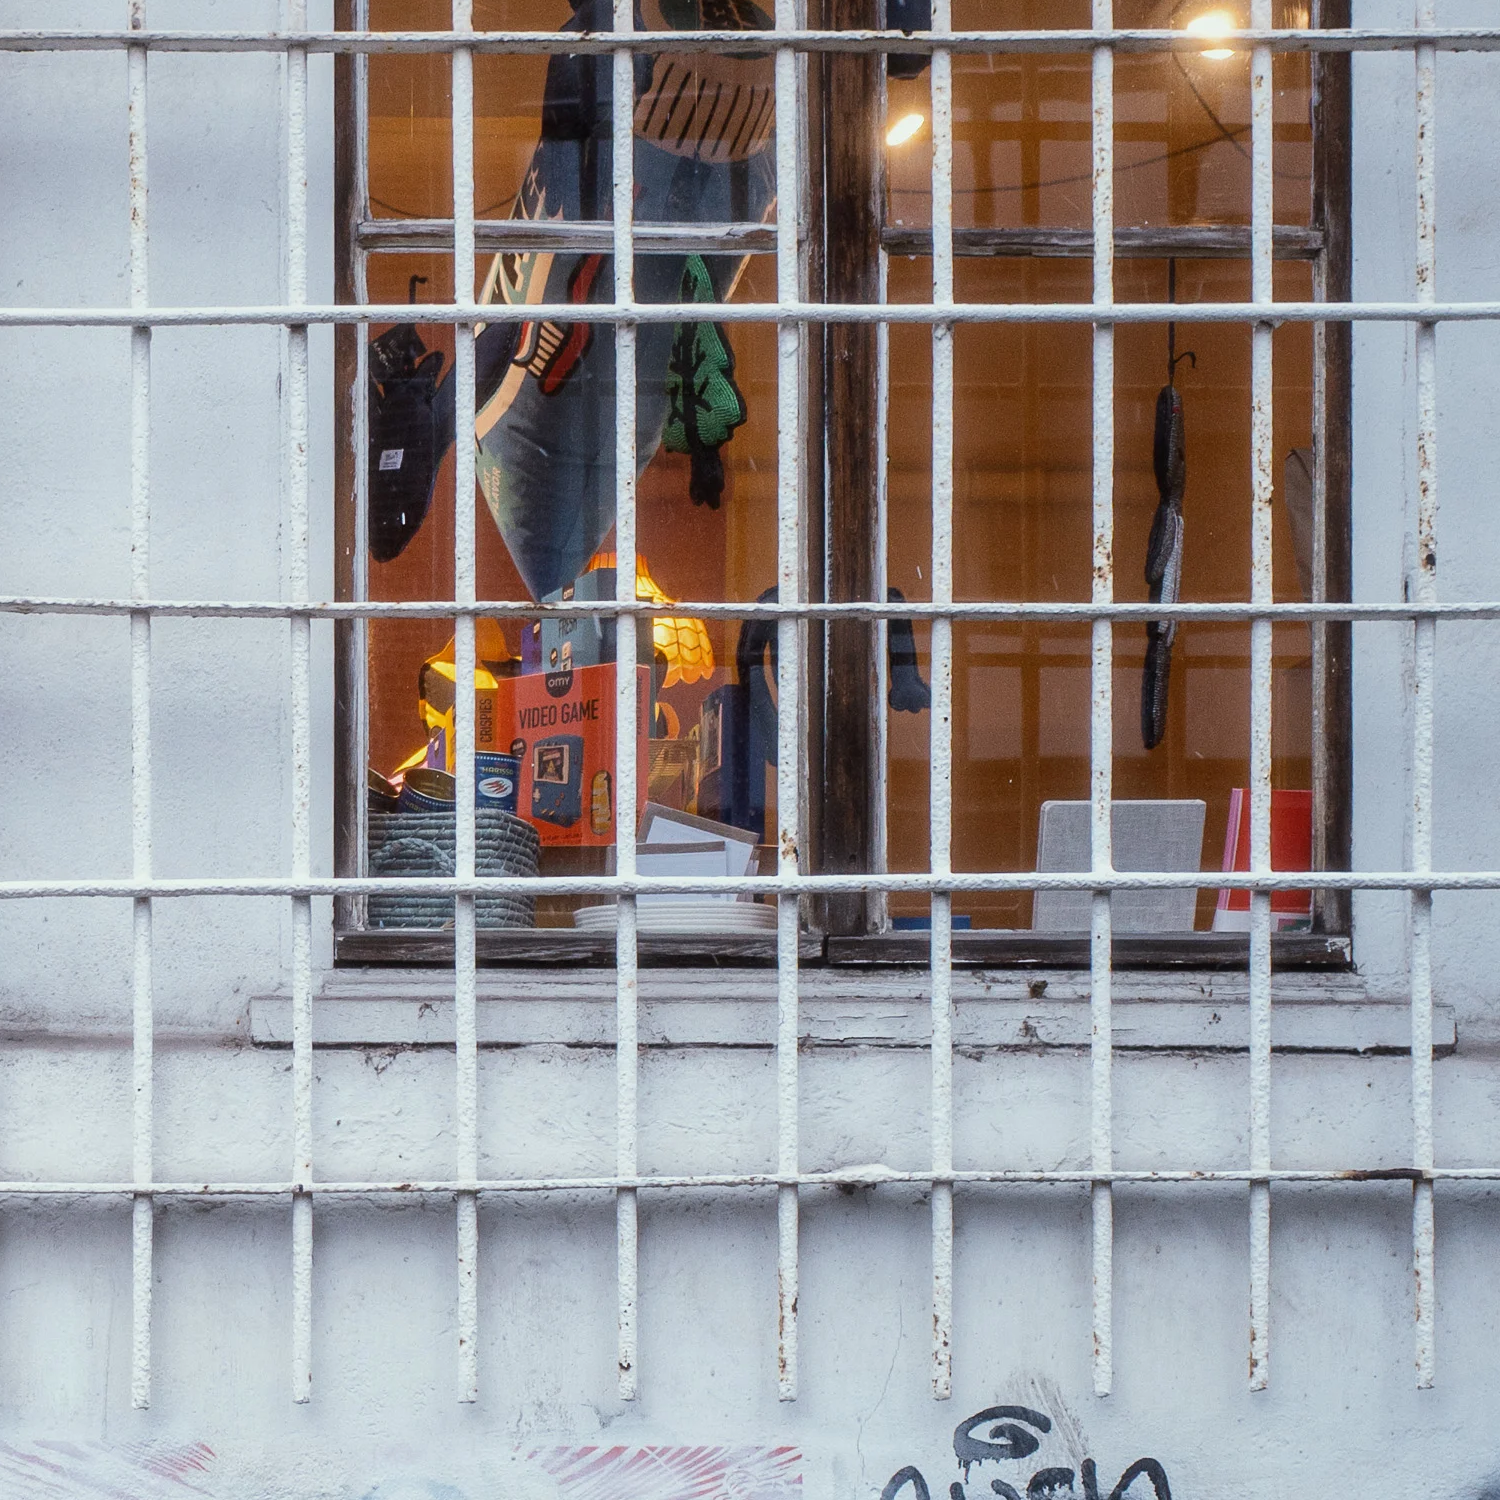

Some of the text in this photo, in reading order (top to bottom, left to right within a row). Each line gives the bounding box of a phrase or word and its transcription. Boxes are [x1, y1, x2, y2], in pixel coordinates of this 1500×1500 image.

[548, 677, 570, 687] omy
[480, 699, 492, 743] CRISPIES
[519, 699, 599, 730] VIDEO GAME
